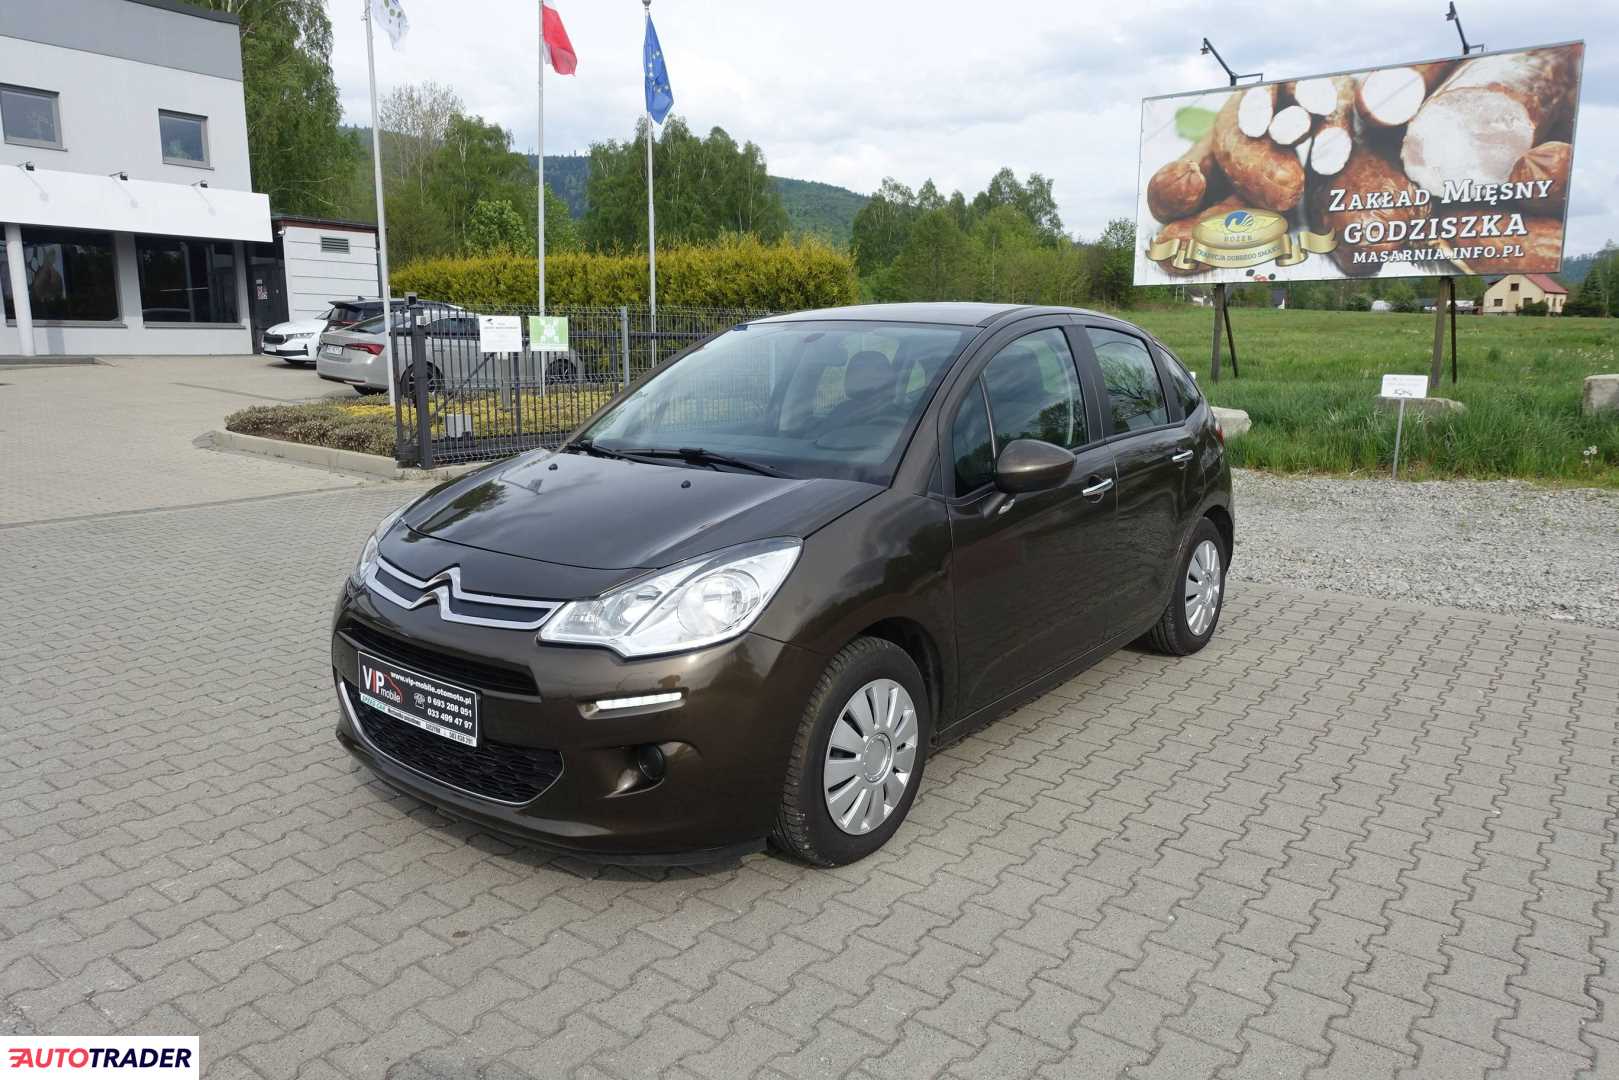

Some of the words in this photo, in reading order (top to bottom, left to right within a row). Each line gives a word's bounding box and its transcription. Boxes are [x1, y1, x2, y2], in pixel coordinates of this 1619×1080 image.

[1328, 188, 1430, 212] ZAKŁAD
[1441, 179, 1552, 206] MIĘSNY
[1343, 213, 1528, 244] GODZISZKA
[1353, 245, 1524, 264] MASARNIA.INFO.PL
[363, 665, 385, 694] VIP
[380, 687, 401, 704] mobile
[427, 696, 432, 704] 0
[433, 698, 445, 708] 693
[446, 702, 459, 713] 208
[460, 706, 472, 718] 051
[427, 708, 440, 719] 033
[440, 713, 453, 724] 499
[454, 717, 463, 727] 47
